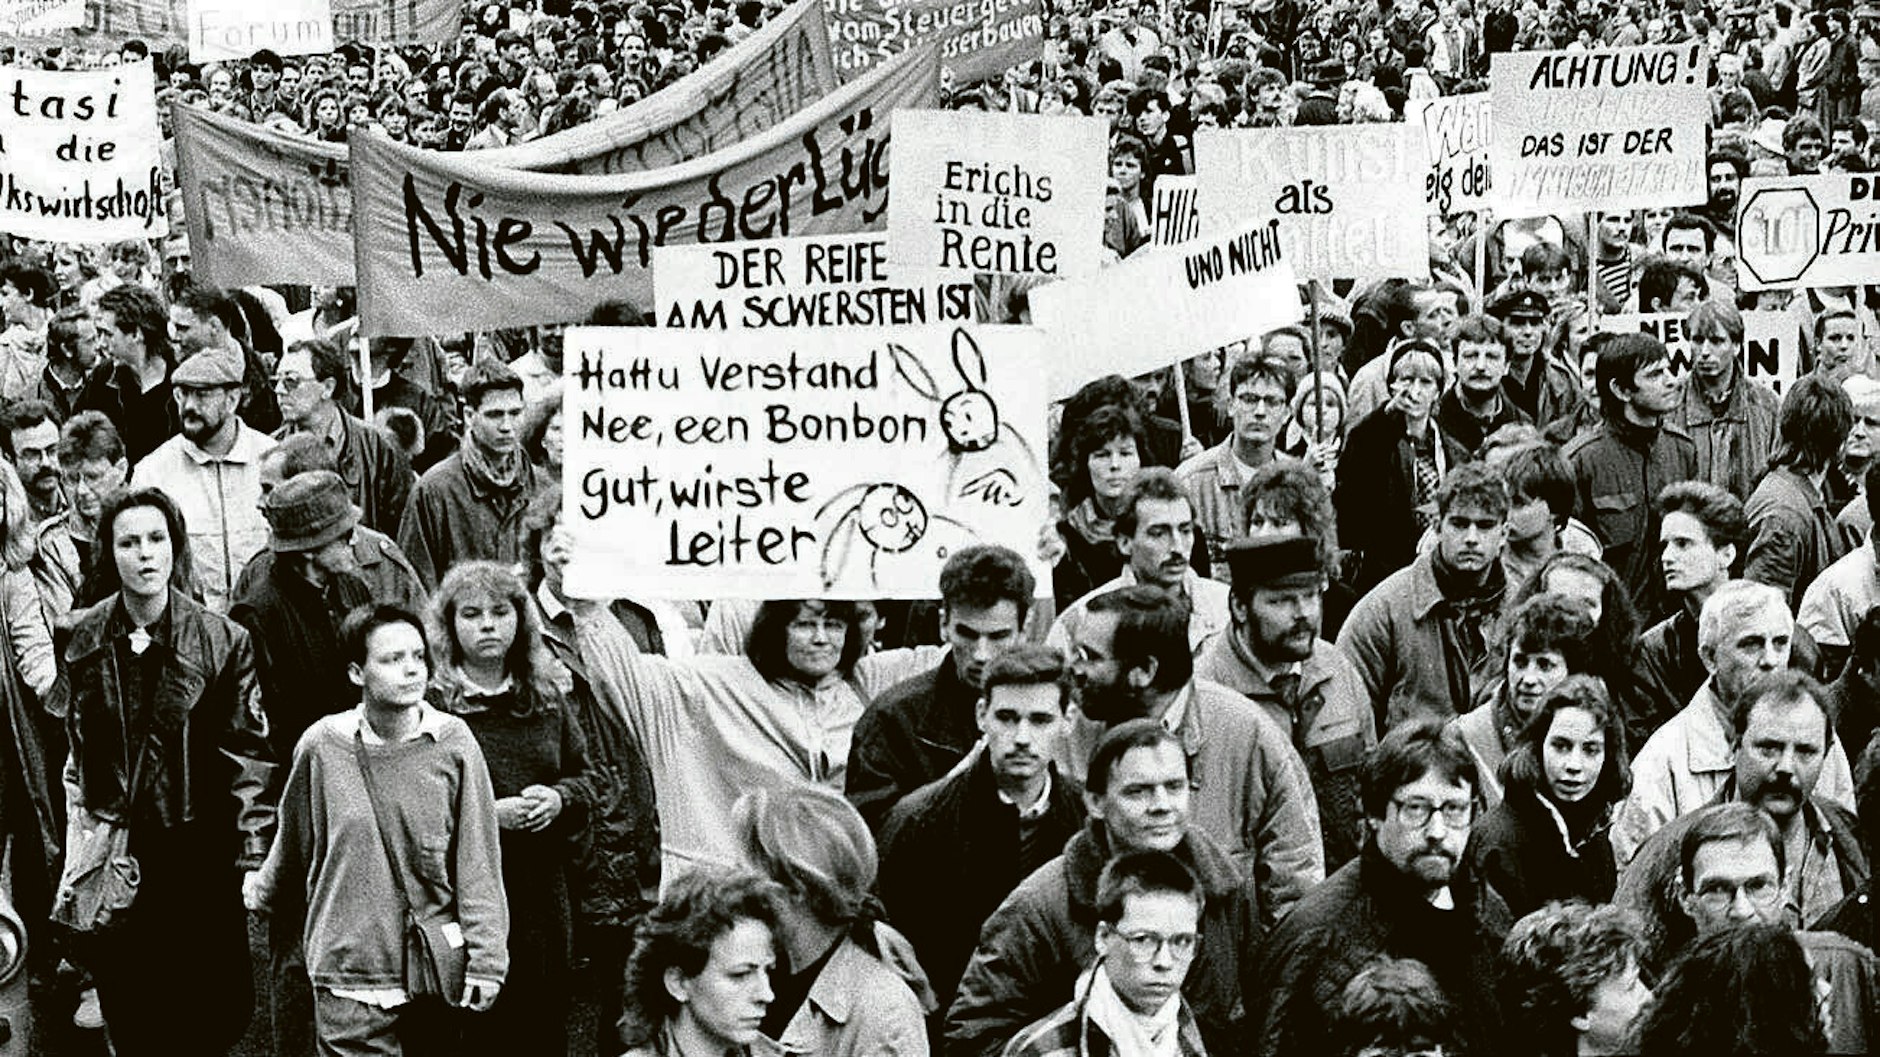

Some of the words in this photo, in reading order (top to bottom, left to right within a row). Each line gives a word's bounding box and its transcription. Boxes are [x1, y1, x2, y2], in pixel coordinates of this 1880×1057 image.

[200, 10, 322, 49] Forum
[56, 133, 116, 162] die
[1520, 132, 1564, 158] DAS
[1577, 132, 1614, 157] IST
[1623, 127, 1673, 155] DER
[944, 161, 1052, 203] Erichs
[1275, 179, 1334, 214] als
[405, 172, 541, 280] Nie
[934, 193, 972, 226] in
[981, 196, 1032, 230] die
[1821, 208, 1880, 255] Pri
[712, 248, 786, 289] DER
[805, 241, 888, 286] REIFE
[939, 228, 1058, 274] Rente
[1185, 245, 1224, 290] UND
[1228, 217, 1281, 276] NICHT
[666, 299, 728, 330] AM
[936, 283, 973, 320] IST
[571, 350, 679, 392] Hattu
[700, 350, 878, 391] Verstand
[582, 406, 663, 446] Nee,
[675, 416, 749, 444] een
[764, 401, 926, 444] Bonbon
[665, 520, 816, 566] Leiter
